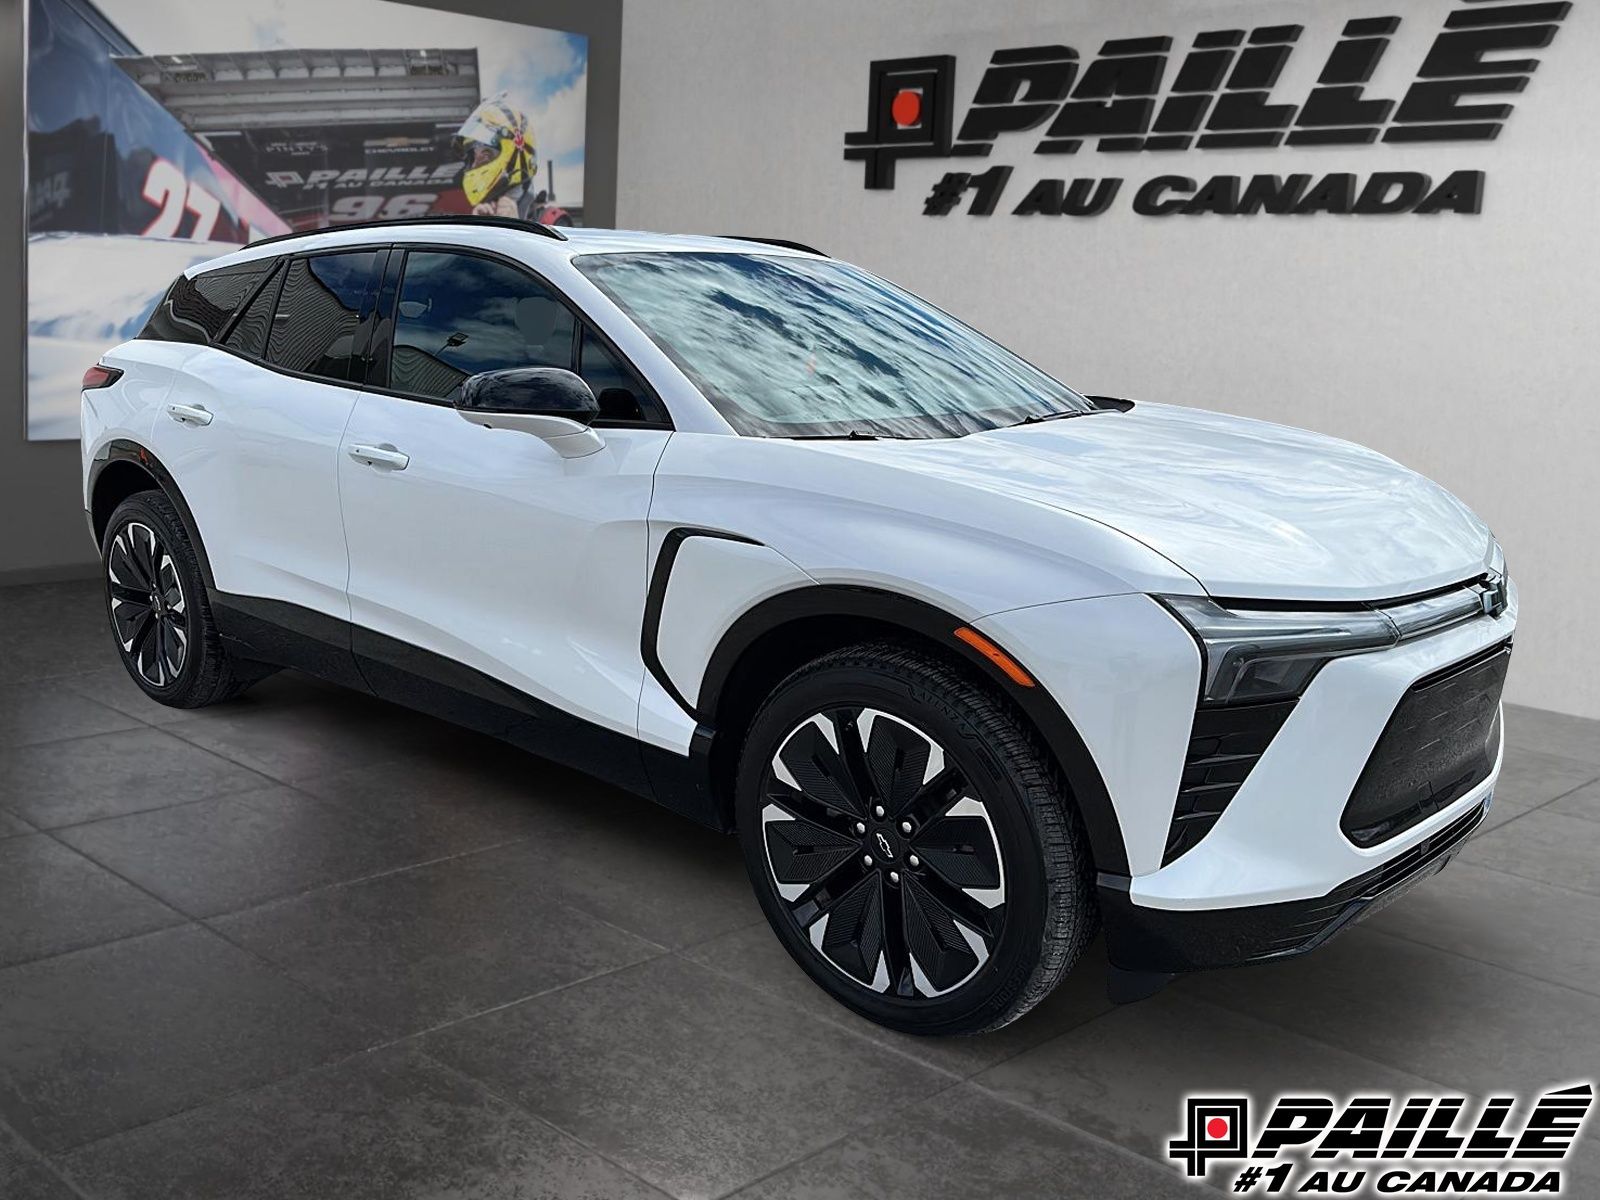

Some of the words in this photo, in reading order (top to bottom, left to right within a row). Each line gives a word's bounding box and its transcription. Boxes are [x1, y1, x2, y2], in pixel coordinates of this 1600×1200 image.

[141, 157, 220, 241] 27
[368, 178, 455, 187] CANADA
[922, 166, 1014, 215] #1
[1011, 178, 1124, 216] AU
[1132, 170, 1486, 216] CANADA
[328, 194, 438, 221] 96
